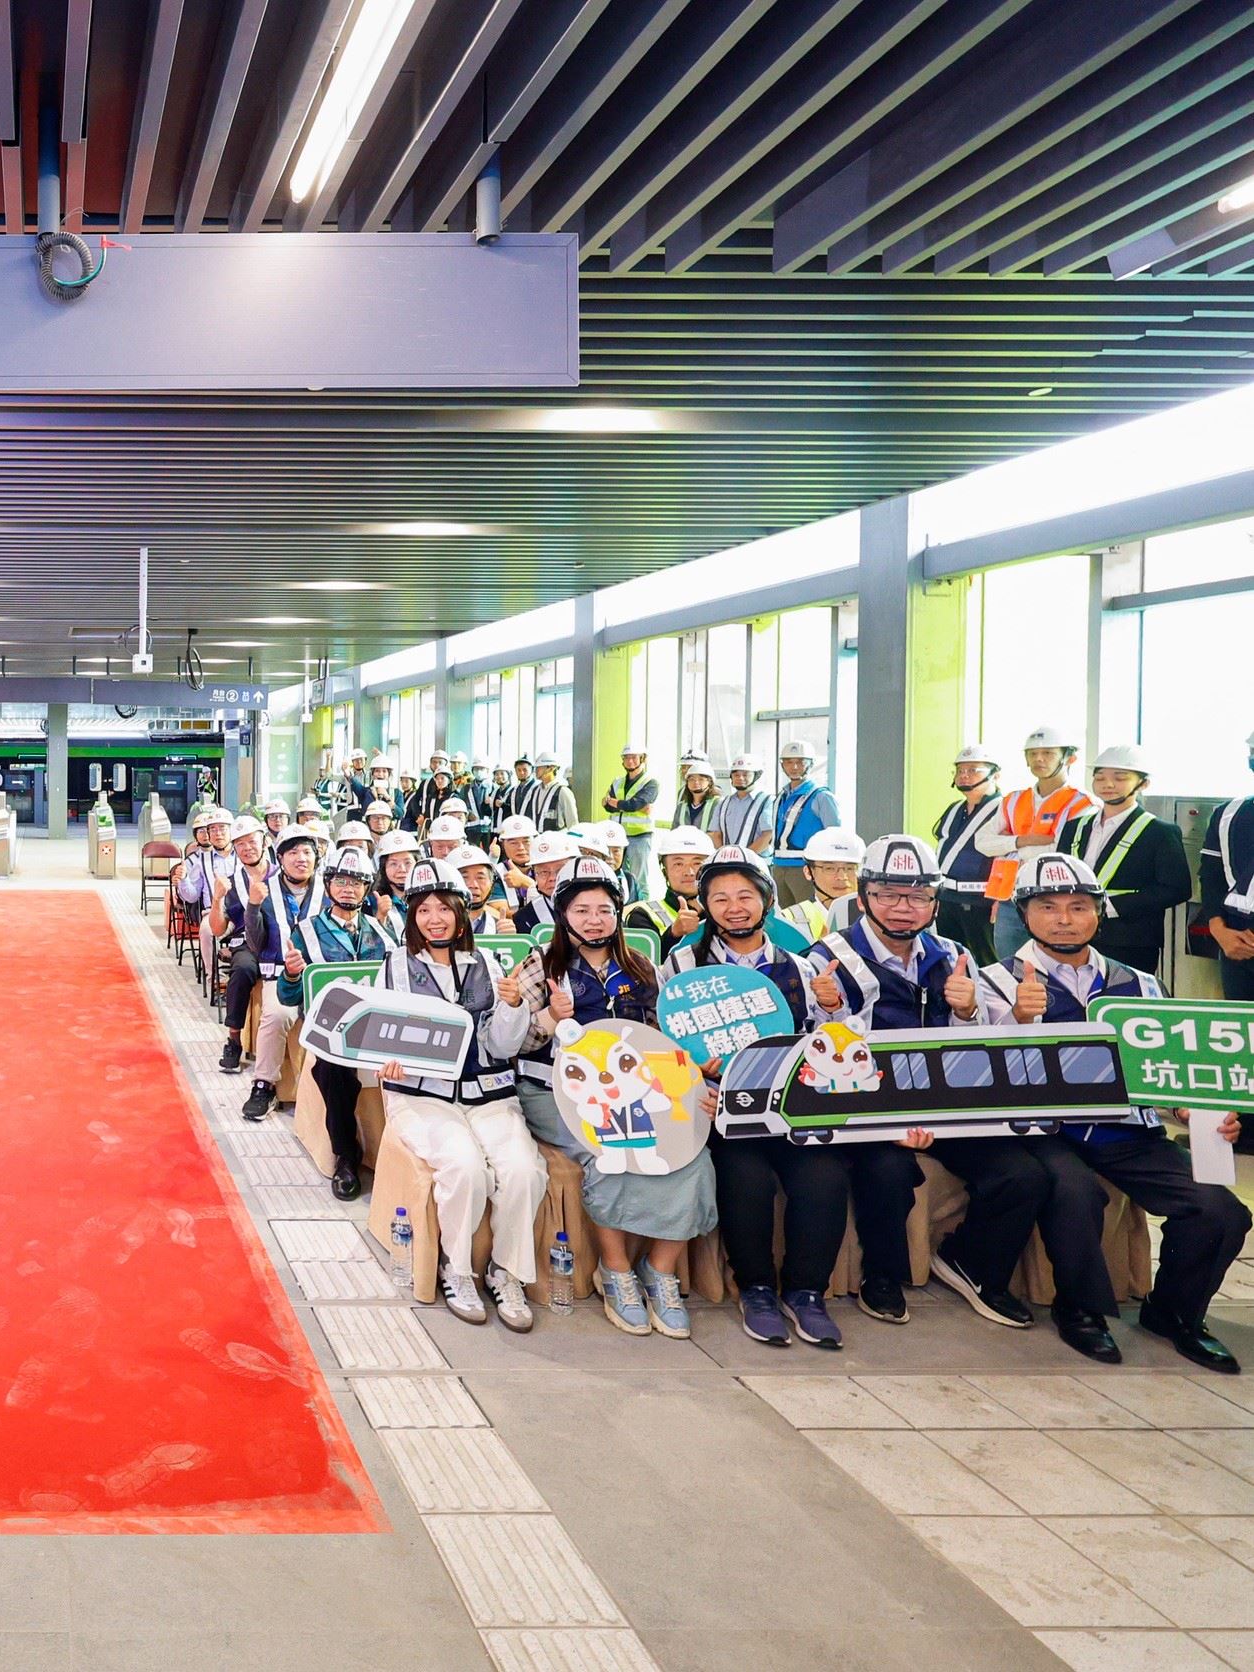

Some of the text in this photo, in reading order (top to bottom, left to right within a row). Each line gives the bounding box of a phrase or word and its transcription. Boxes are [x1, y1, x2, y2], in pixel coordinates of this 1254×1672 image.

[666, 987, 778, 1039] 桃園捷運
[1121, 1016, 1254, 1054] G15
